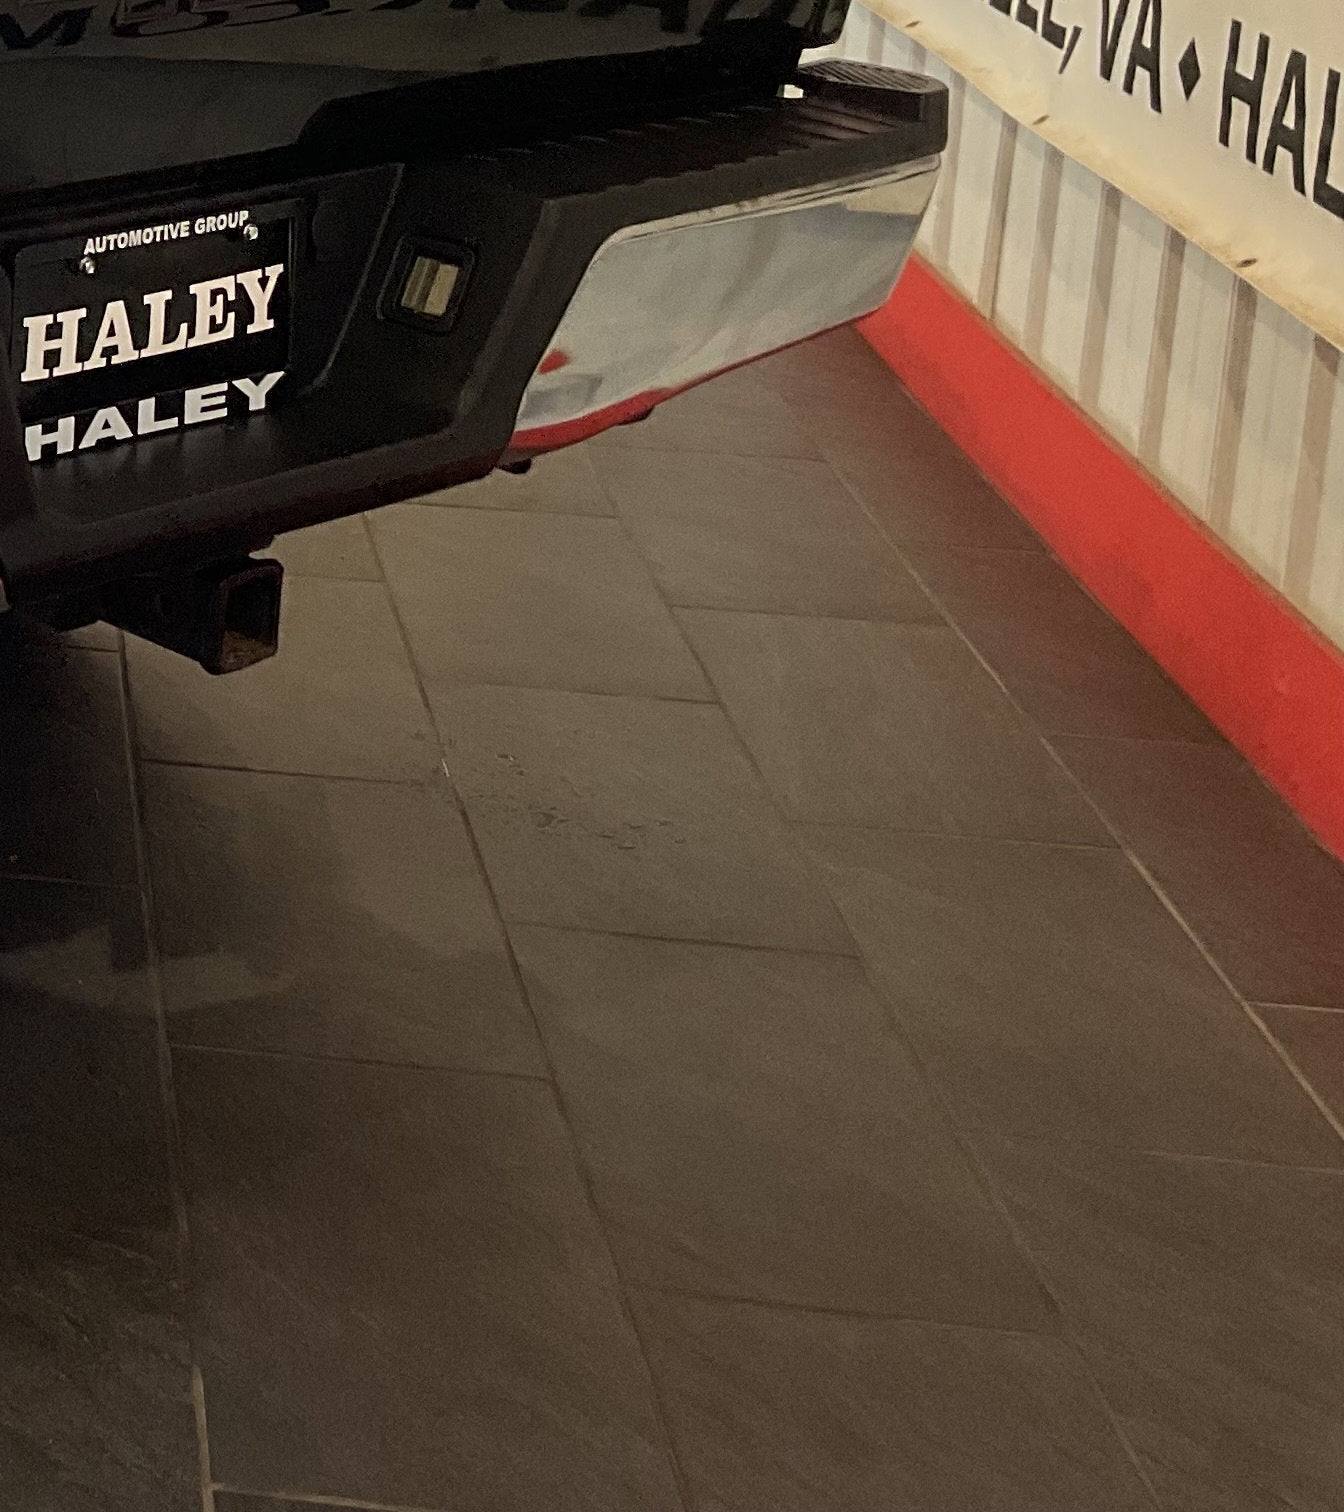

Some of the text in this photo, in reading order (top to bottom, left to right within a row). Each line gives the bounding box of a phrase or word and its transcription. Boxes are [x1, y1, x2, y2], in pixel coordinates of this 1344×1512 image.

[83, 210, 250, 256] AUTOMOTIVE GROUP
[21, 263, 285, 382] HALEY
[24, 370, 287, 462] HALEY
